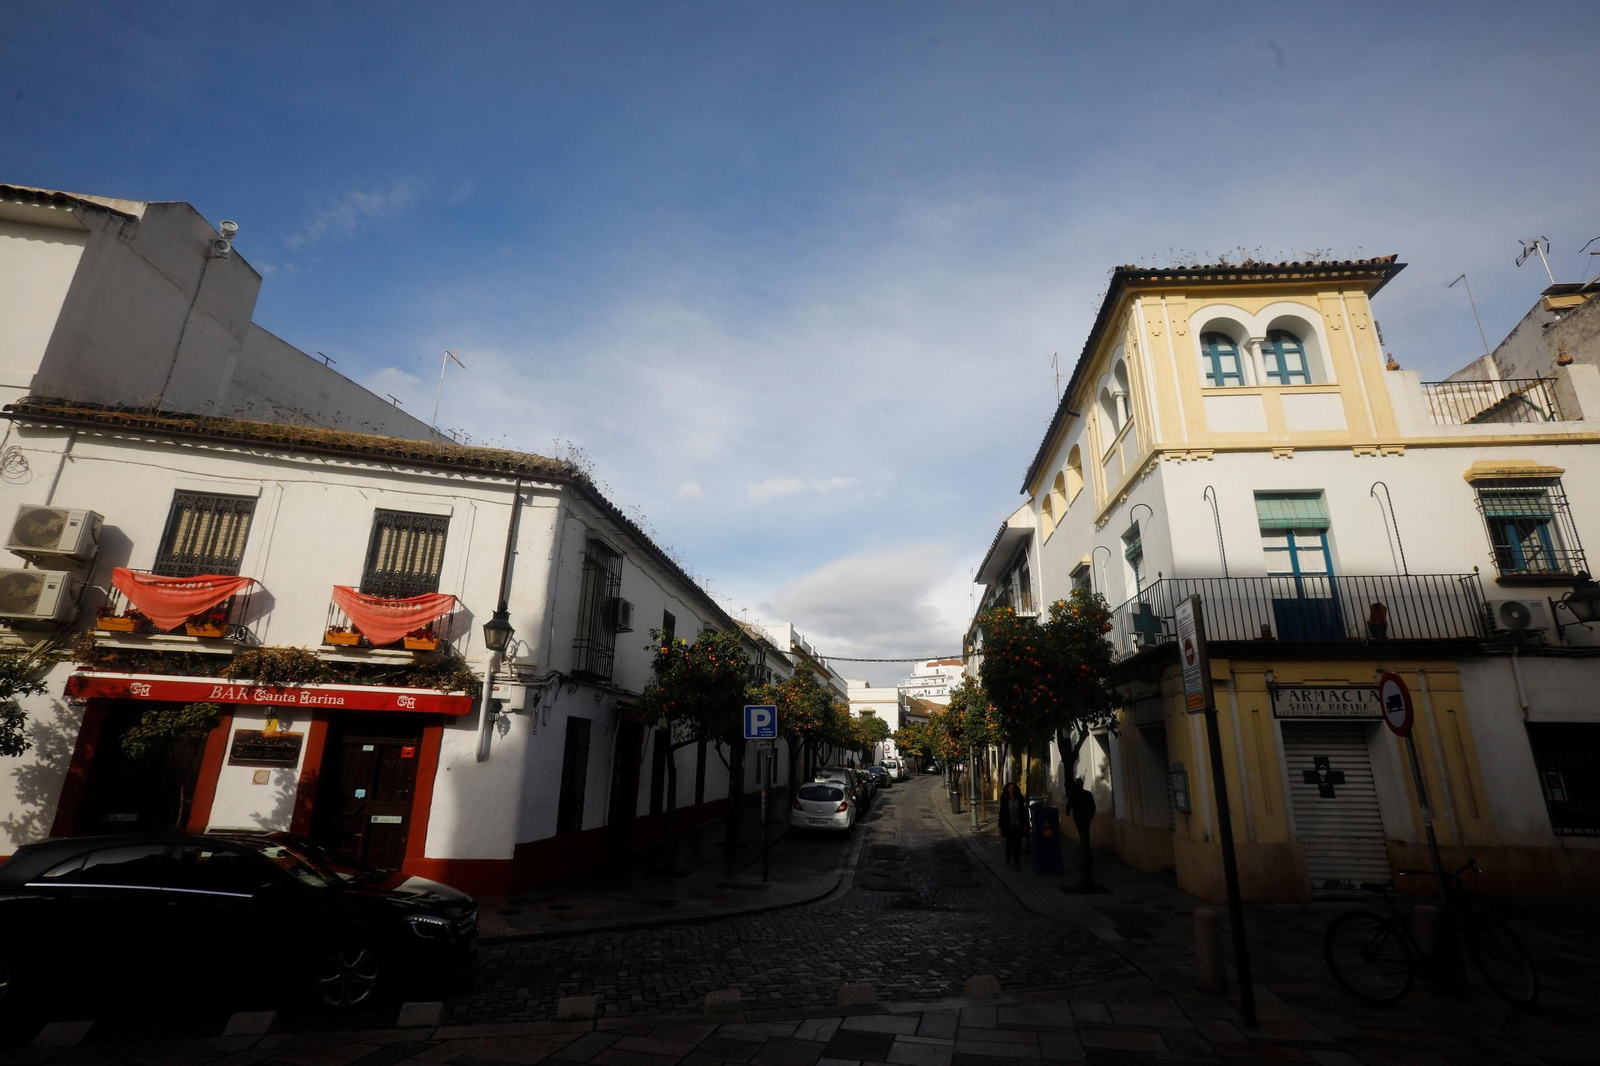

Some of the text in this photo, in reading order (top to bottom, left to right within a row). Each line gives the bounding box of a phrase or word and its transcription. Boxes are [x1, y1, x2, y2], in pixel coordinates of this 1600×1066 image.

[209, 685, 345, 705] BAR Santa Marina
[1275, 690, 1381, 702] FARMACIA
[1289, 703, 1369, 711] SANTA MARINA
[751, 709, 771, 735] P
